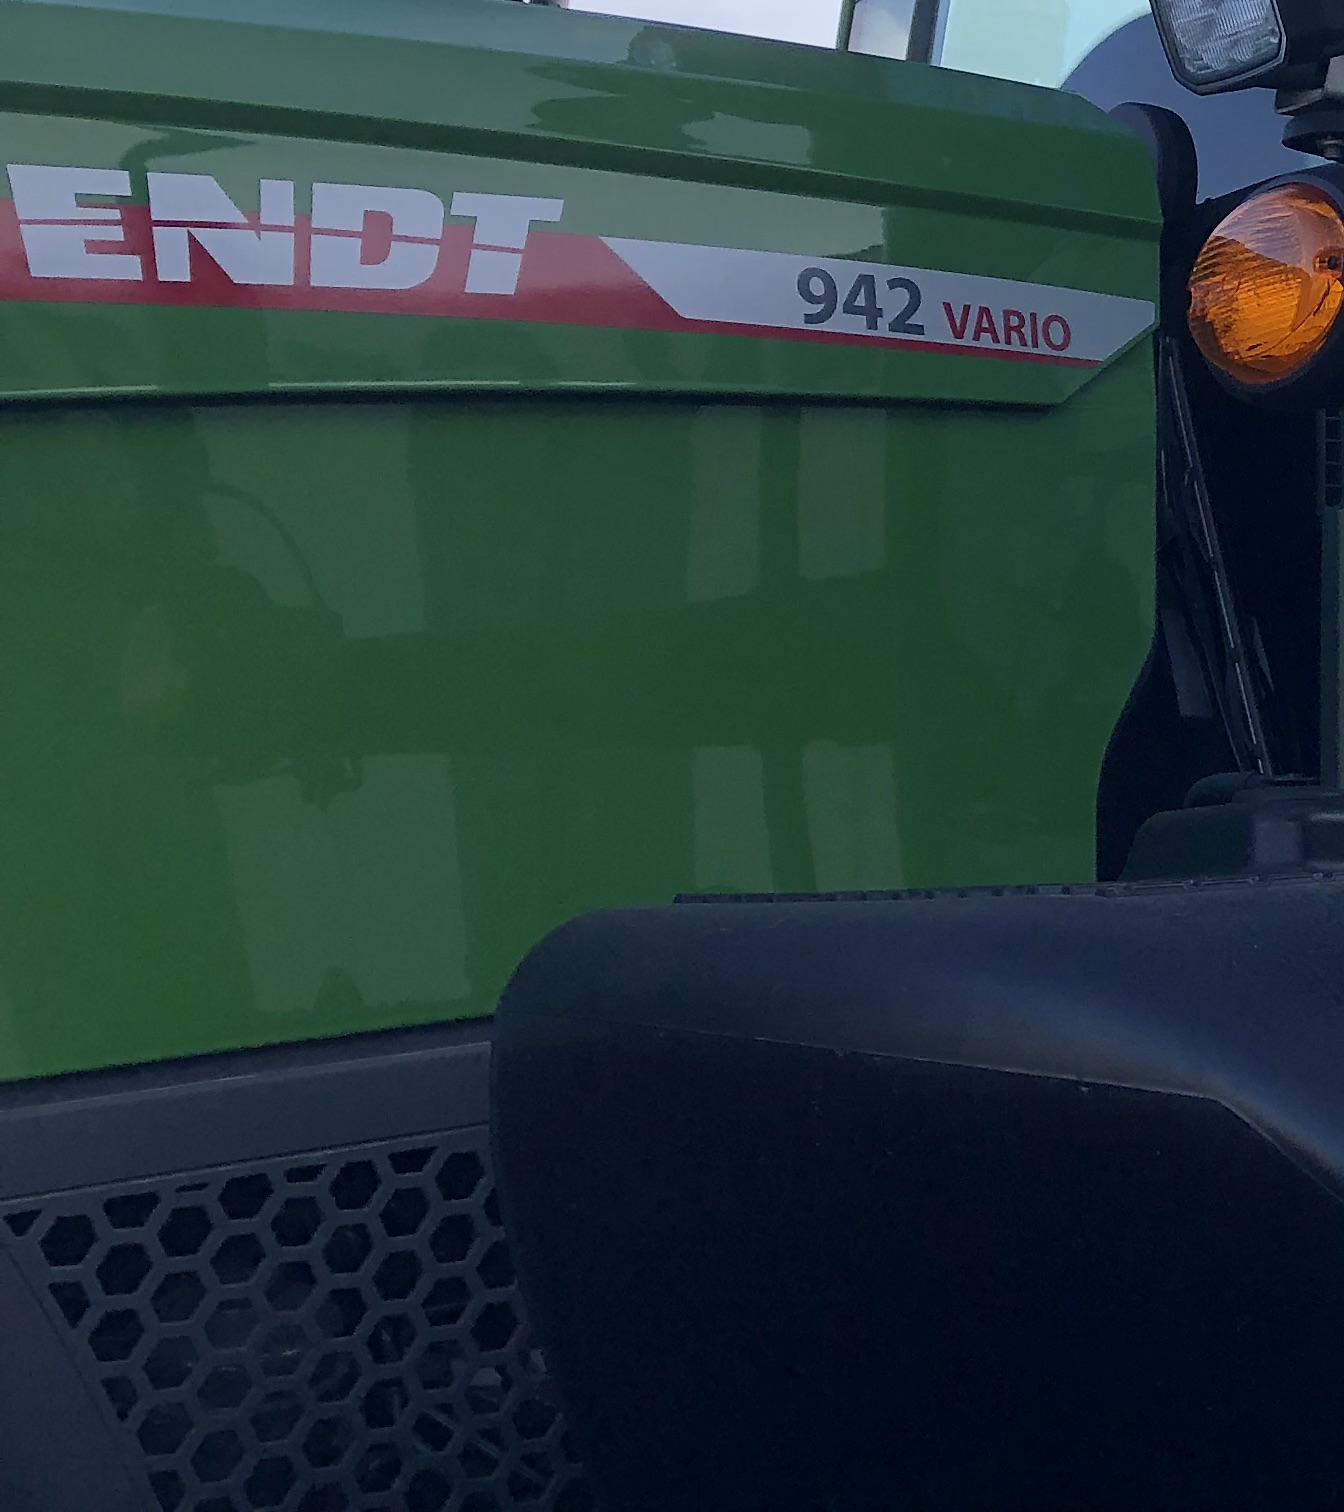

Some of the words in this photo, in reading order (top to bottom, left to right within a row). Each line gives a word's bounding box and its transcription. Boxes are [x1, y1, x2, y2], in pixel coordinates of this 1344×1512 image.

[6, 163, 564, 295] ENDT
[797, 267, 925, 336] 942
[942, 301, 1072, 352] VARIO
